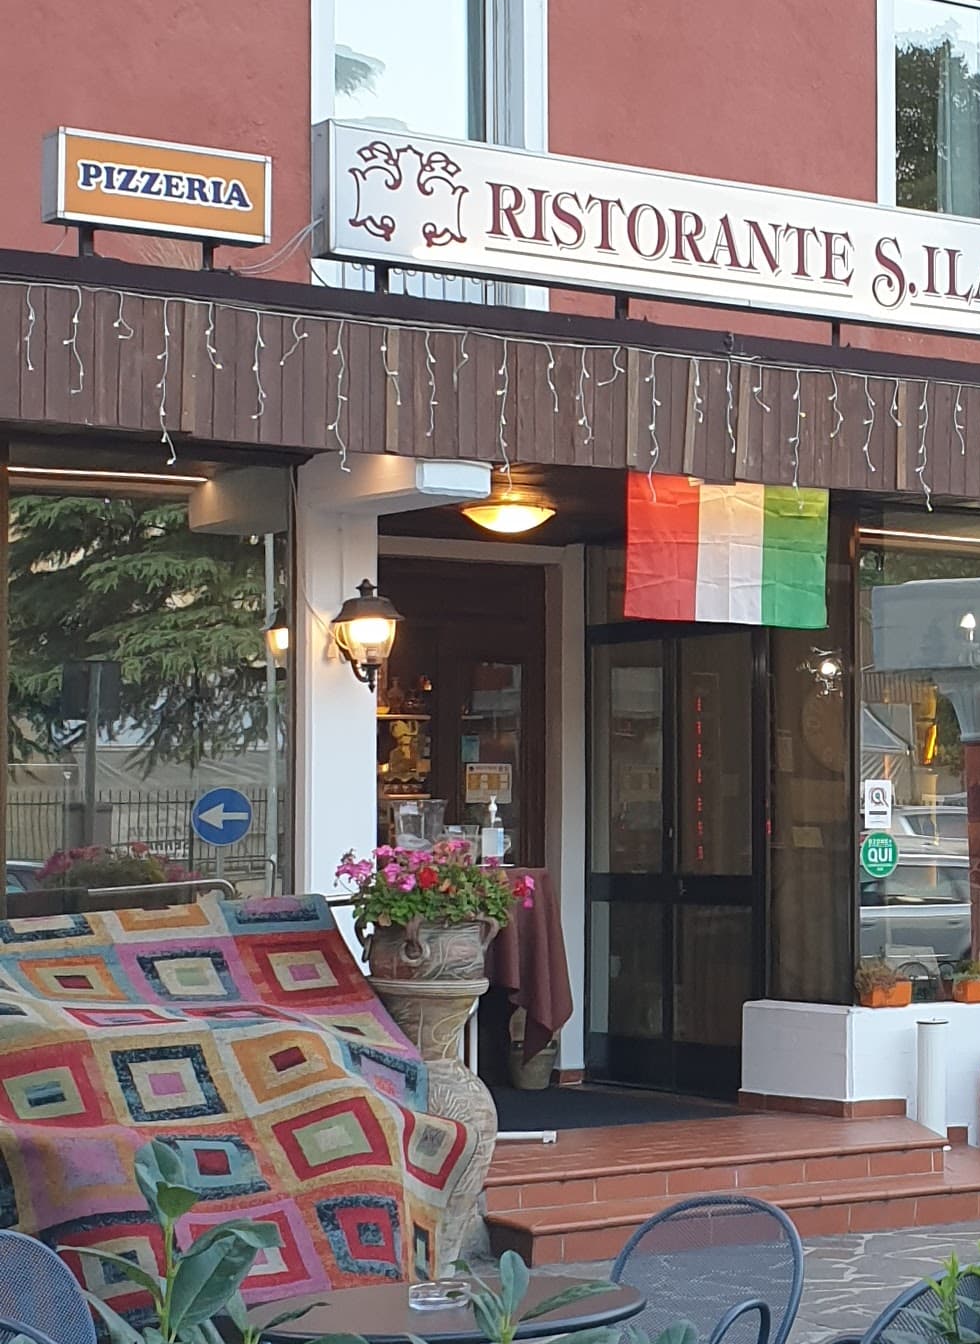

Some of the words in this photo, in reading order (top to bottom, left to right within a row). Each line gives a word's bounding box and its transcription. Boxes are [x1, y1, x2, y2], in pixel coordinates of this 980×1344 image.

[79, 162, 250, 208] PIZZERIA
[481, 180, 855, 287] RISTORANTE
[867, 847, 893, 863] QUI
